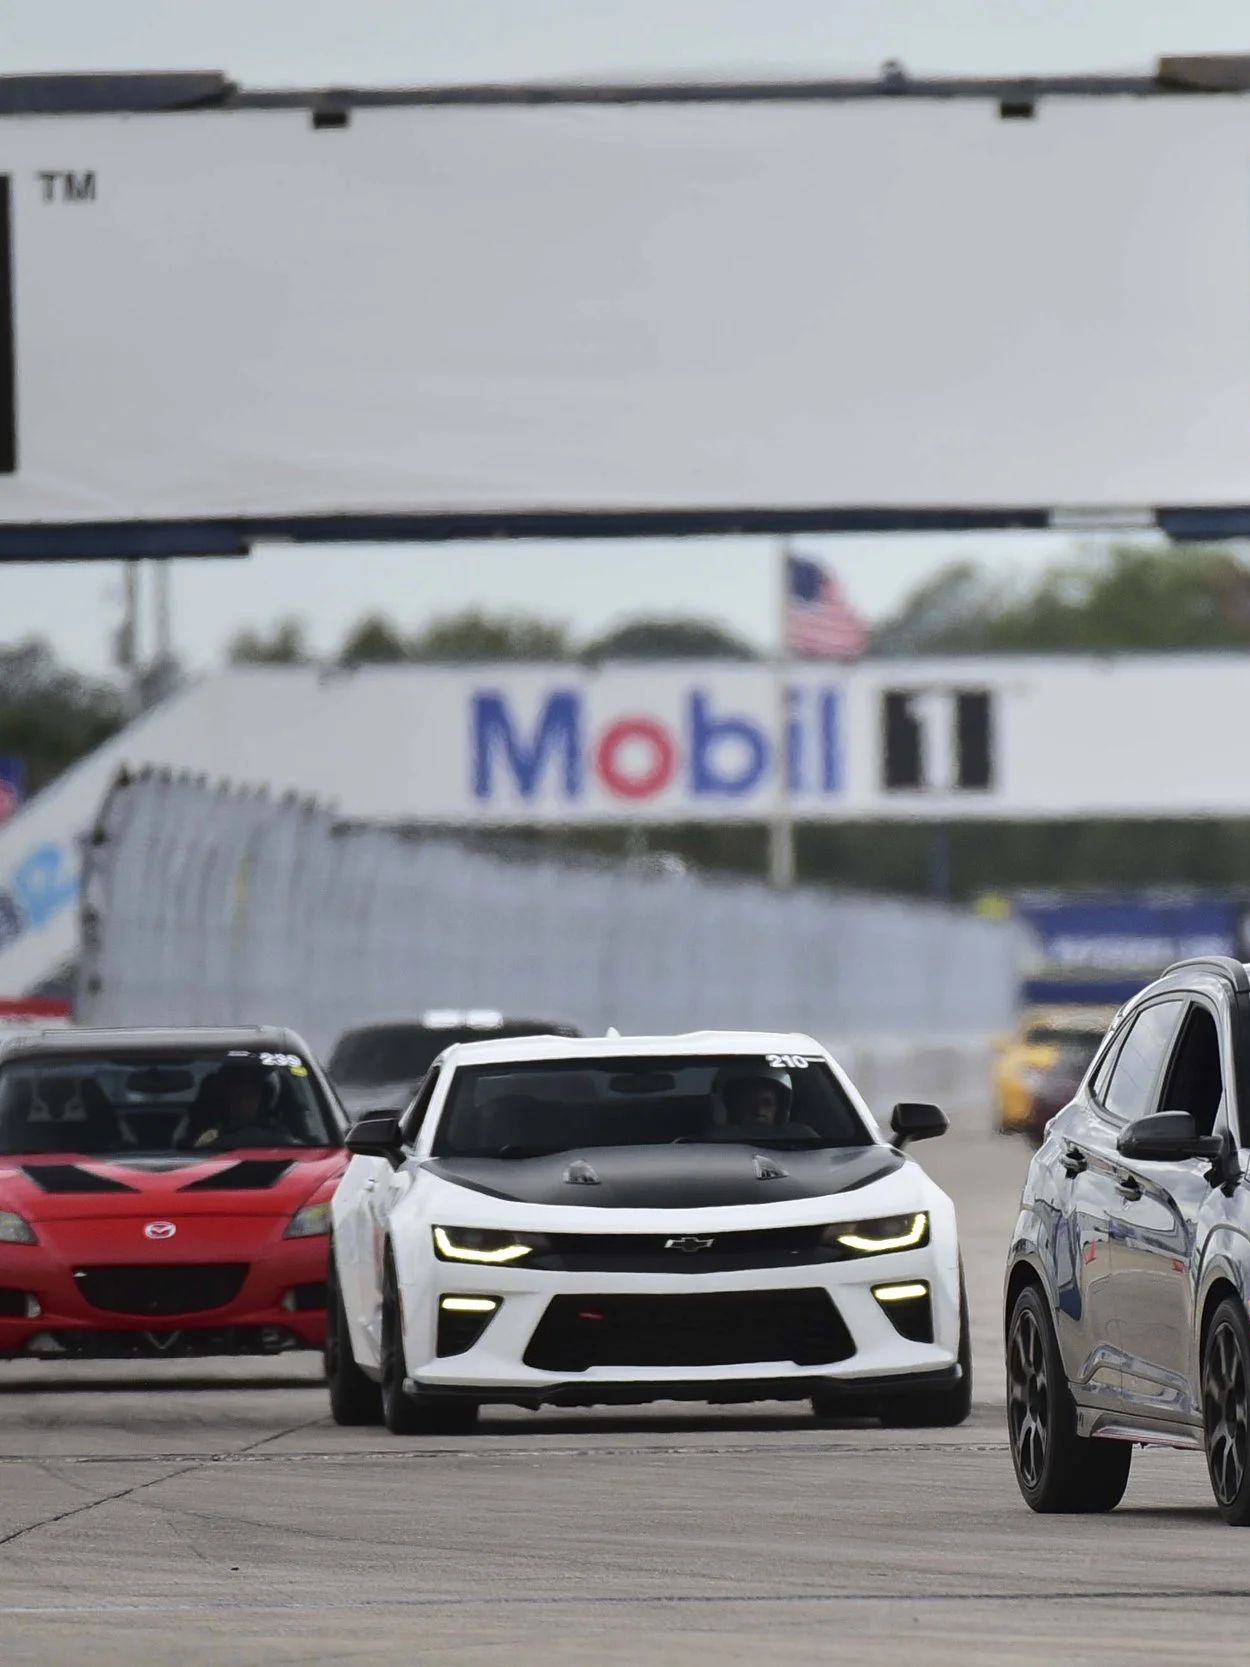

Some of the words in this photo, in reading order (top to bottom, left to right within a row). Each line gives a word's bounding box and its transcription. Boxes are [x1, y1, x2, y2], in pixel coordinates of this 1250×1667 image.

[37, 169, 98, 204] TM
[468, 687, 845, 800] Mobil
[765, 1054, 809, 1068] 210
